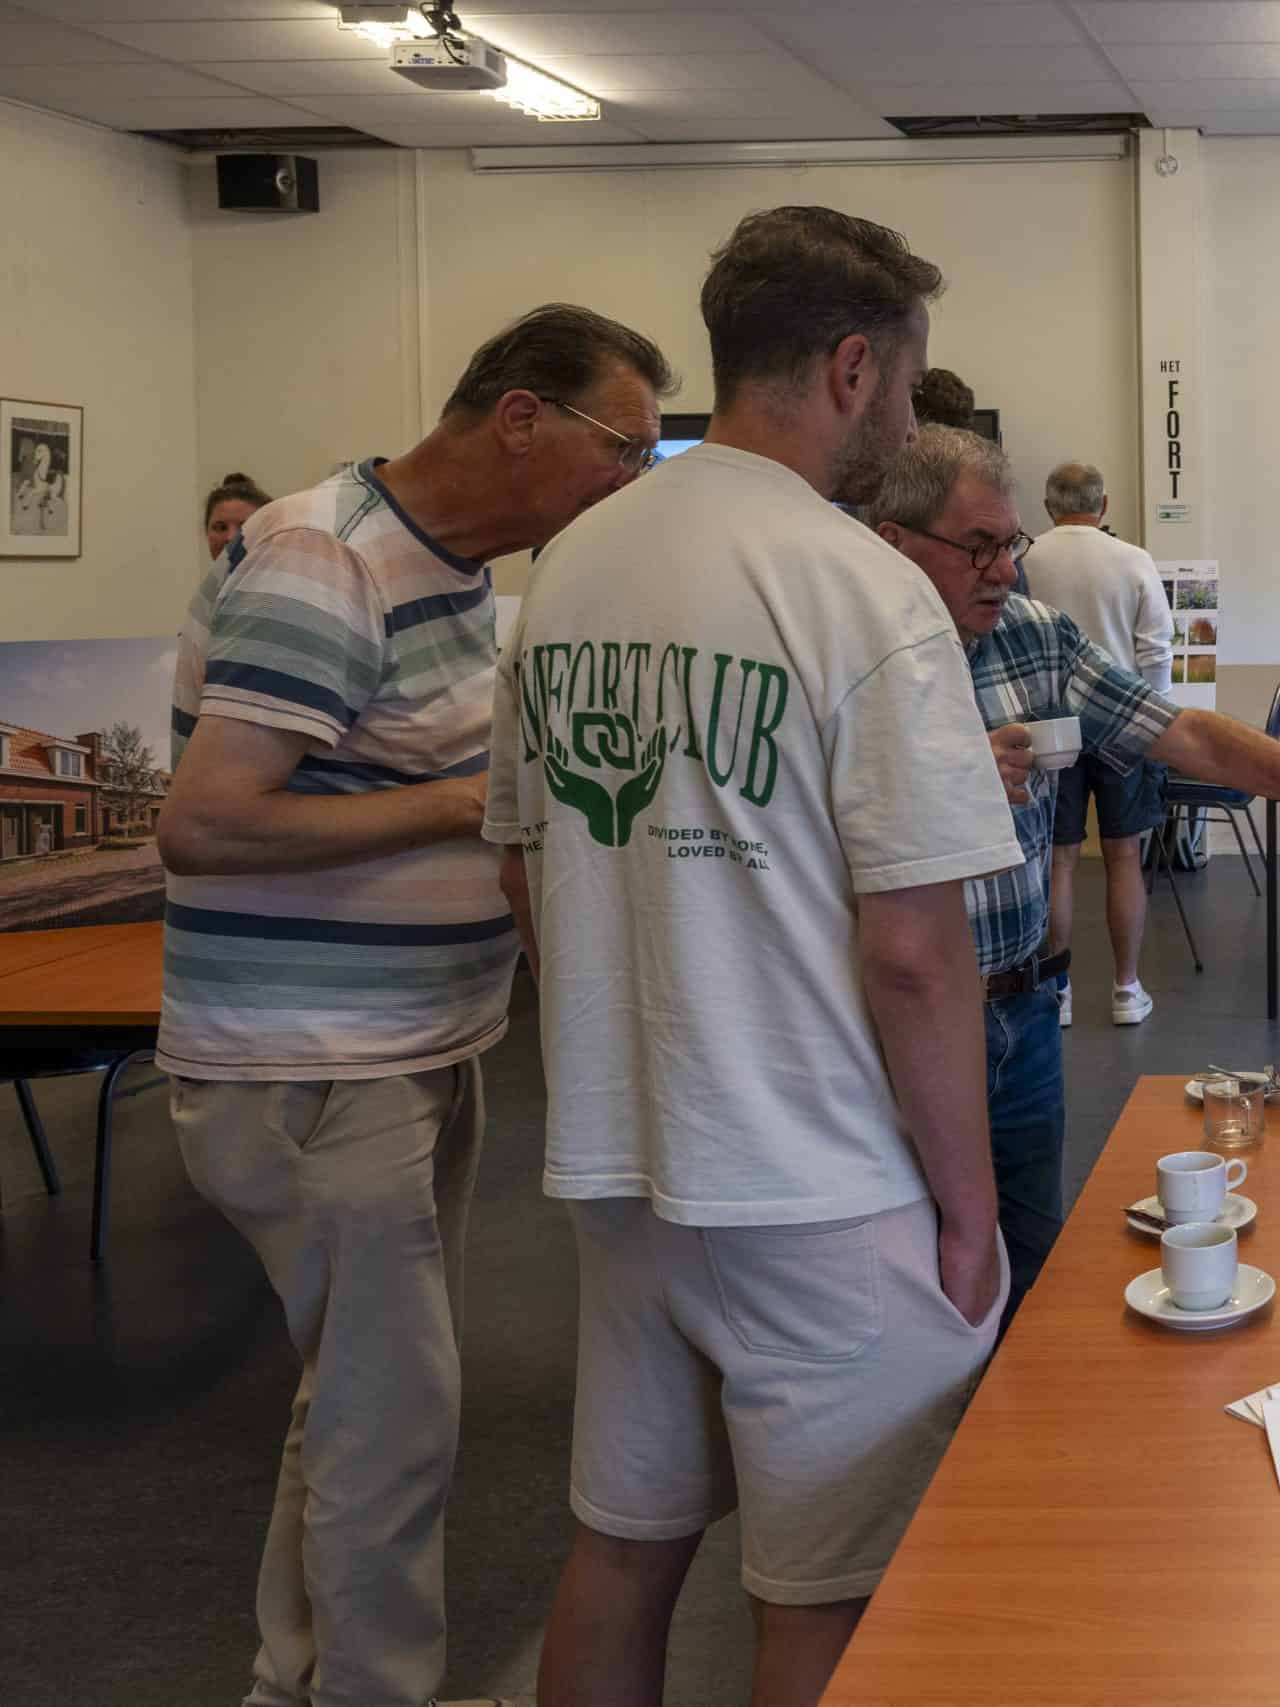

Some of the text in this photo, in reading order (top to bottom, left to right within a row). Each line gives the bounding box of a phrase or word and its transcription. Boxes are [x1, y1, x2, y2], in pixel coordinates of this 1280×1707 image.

[1160, 360, 1181, 373] HET
[1166, 380, 1181, 499] FORT
[656, 642, 790, 808] CLUB
[647, 824, 705, 841] DIVIDED
[667, 845, 726, 858] LOVED
